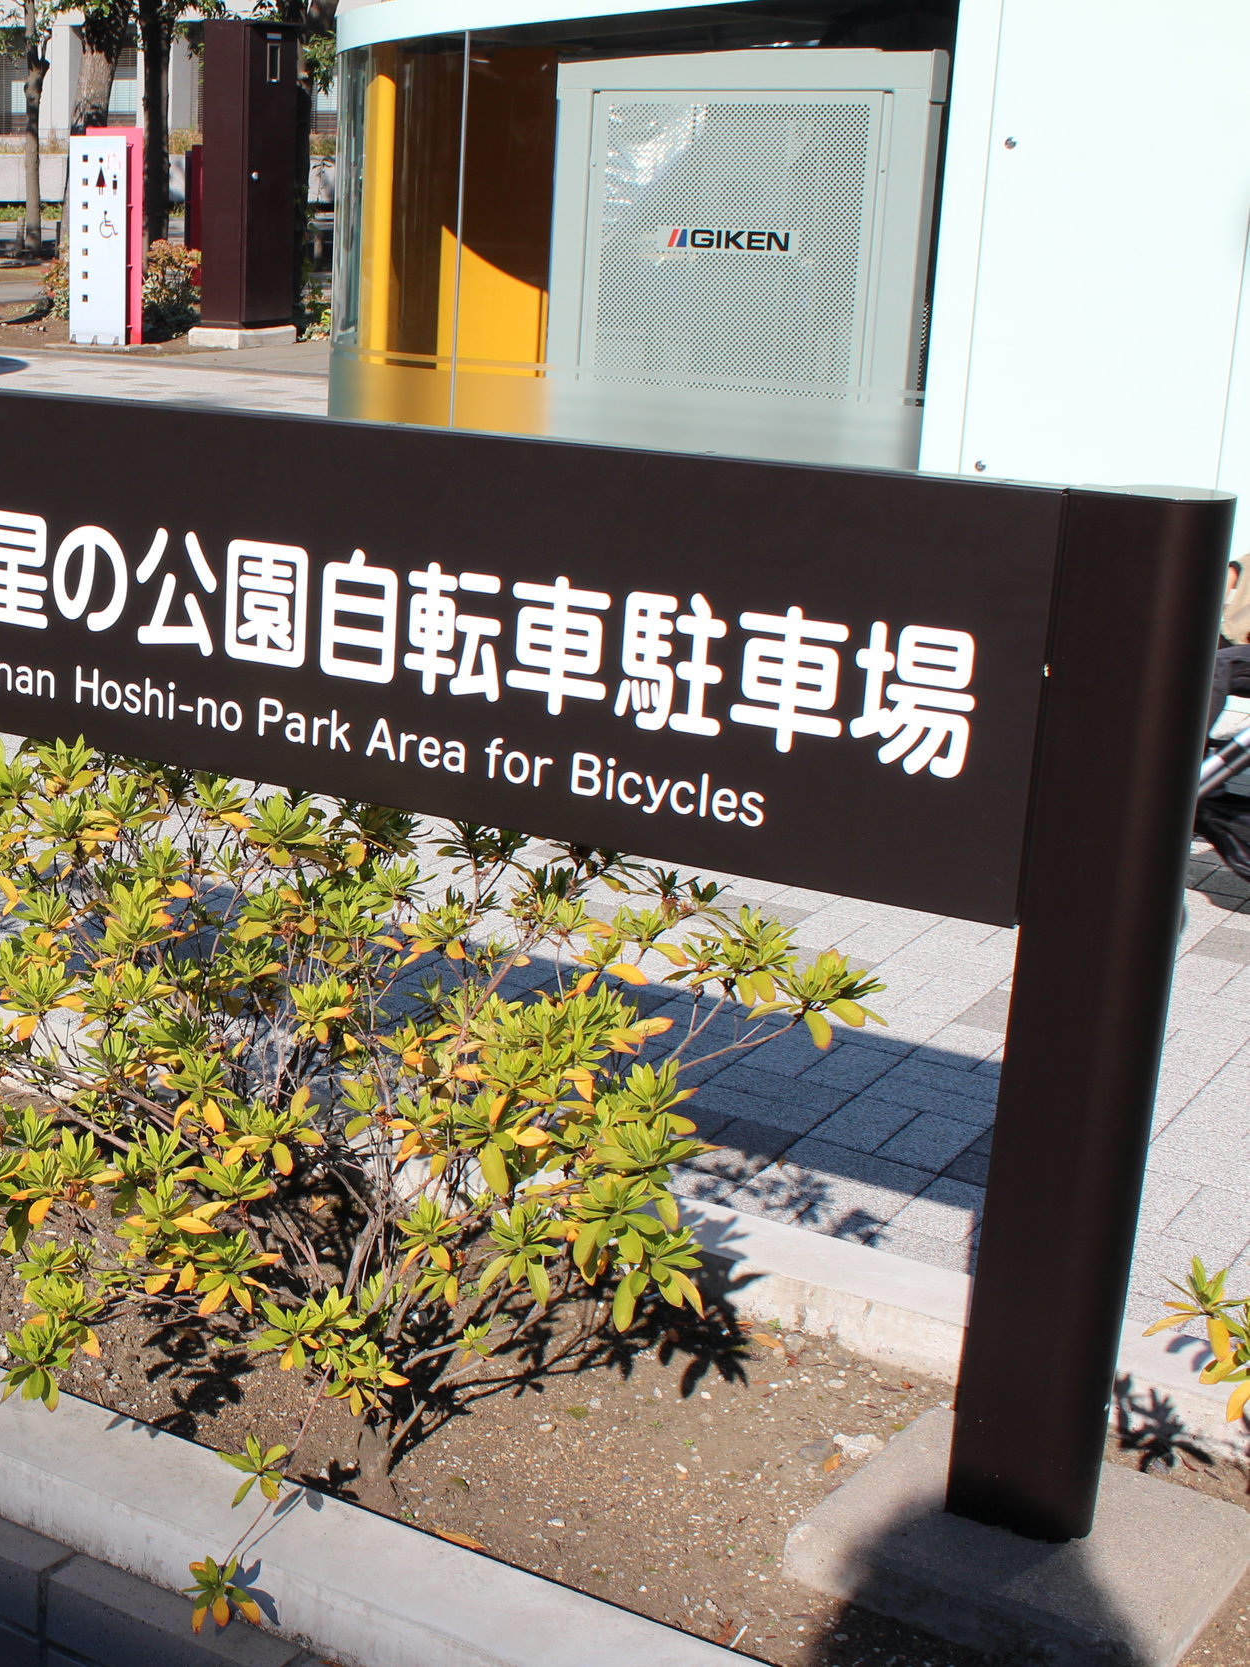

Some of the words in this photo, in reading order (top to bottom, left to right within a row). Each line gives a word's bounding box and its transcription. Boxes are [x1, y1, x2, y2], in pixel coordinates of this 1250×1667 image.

[690, 229, 790, 252] GIKEN
[75, 665, 243, 732] Hoshi-no
[257, 697, 352, 753] Park
[365, 717, 467, 774] Area
[484, 737, 554, 788] for
[570, 751, 765, 828] Bicycles
